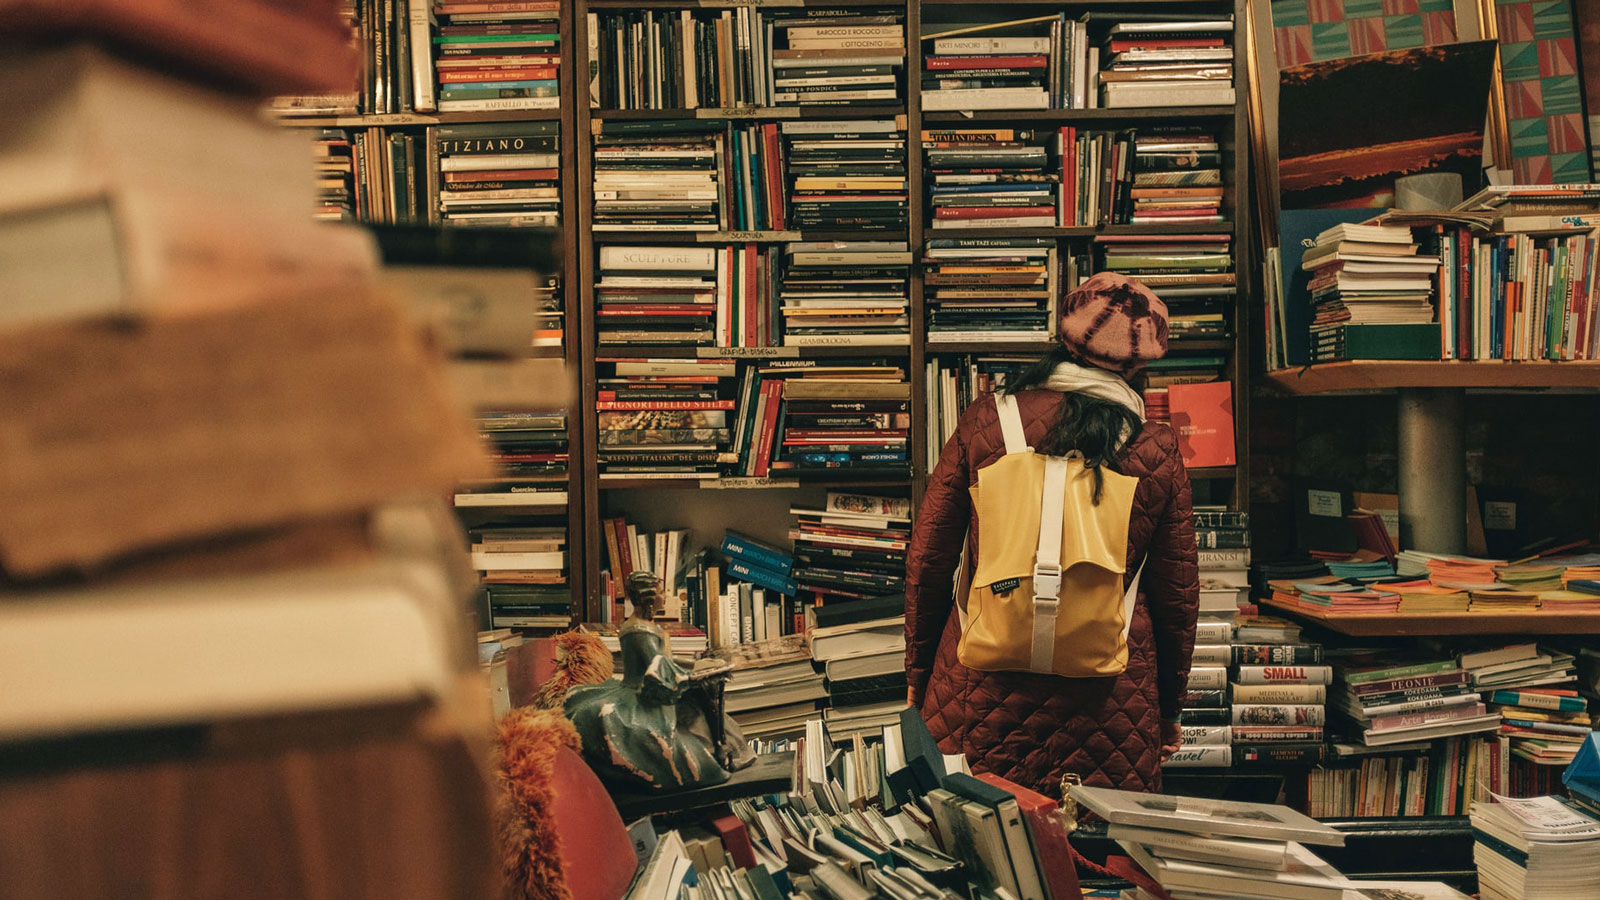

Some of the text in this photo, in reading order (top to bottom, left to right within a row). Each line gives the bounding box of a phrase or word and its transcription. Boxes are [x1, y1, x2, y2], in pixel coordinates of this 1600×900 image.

[442, 138, 524, 152] TIZIANO
[624, 254, 690, 263] SCULPTURE
[1194, 512, 1223, 527] ALI
[726, 543, 744, 554] MINI
[732, 564, 750, 575] MINI
[729, 592, 738, 629] CONCEPT
[744, 617, 752, 644] BMW
[1263, 667, 1308, 680] SMALL
[1390, 677, 1435, 690] PEONIE
[1400, 715, 1422, 726] Arte
[1170, 749, 1206, 761] ravel
